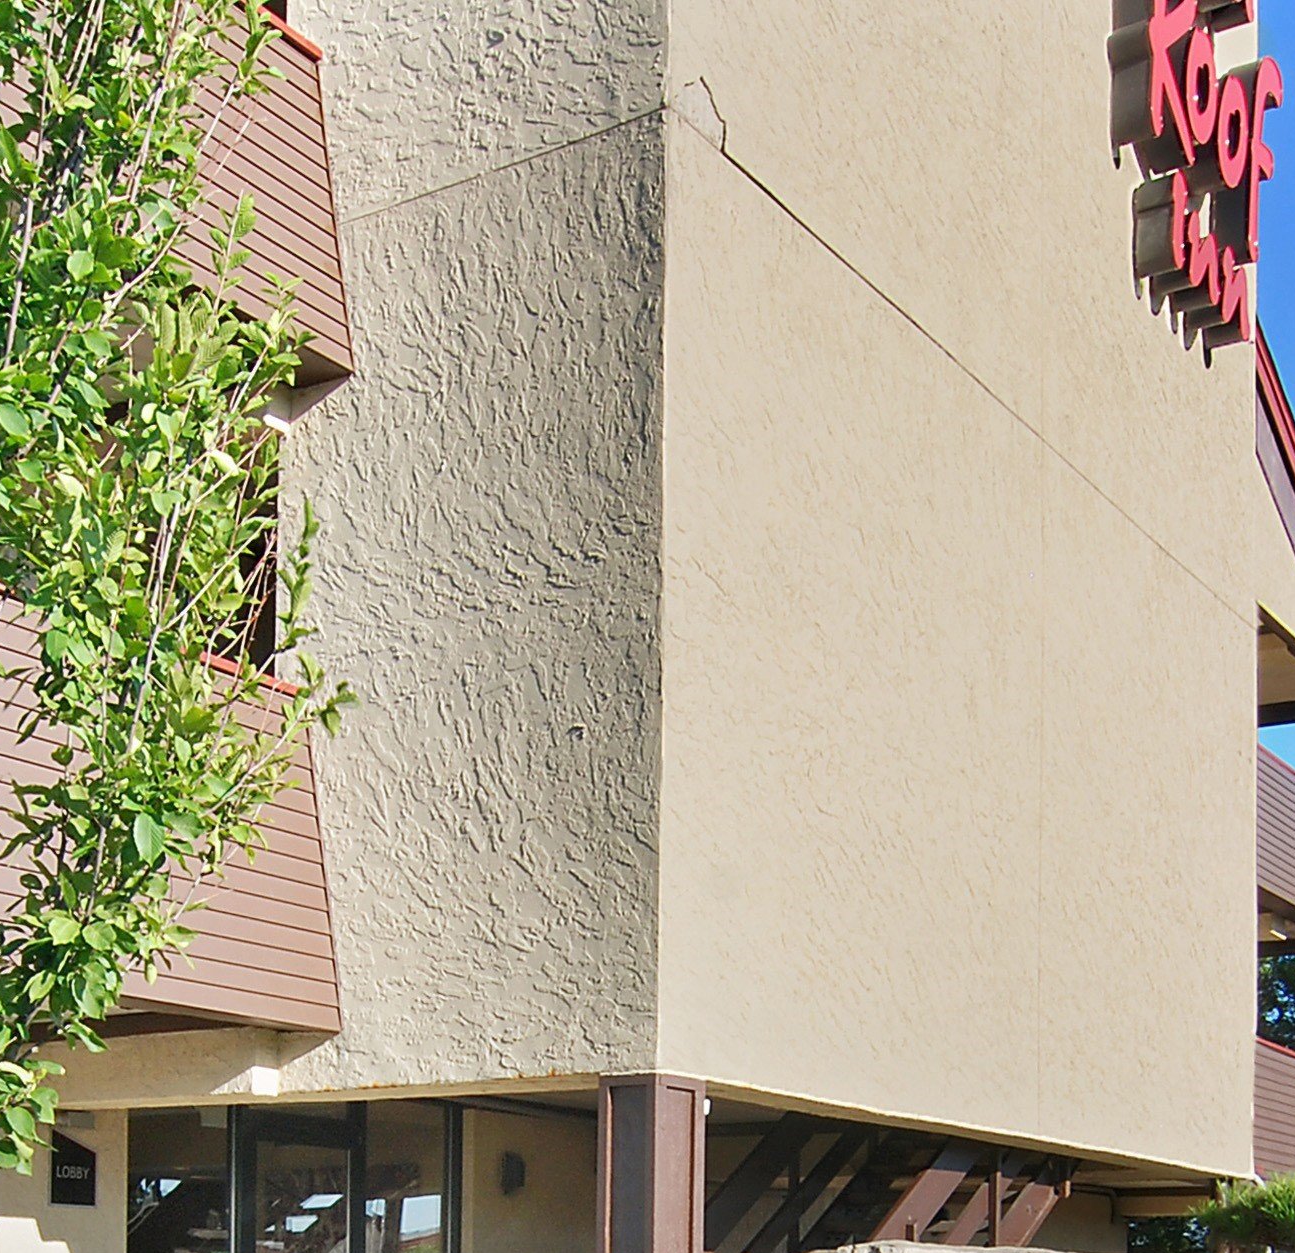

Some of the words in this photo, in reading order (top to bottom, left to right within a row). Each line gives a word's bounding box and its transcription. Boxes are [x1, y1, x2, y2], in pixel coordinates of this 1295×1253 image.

[1149, 0, 1283, 262] Roof
[1172, 169, 1249, 341] Inn
[56, 1165, 90, 1179] LOBBY
